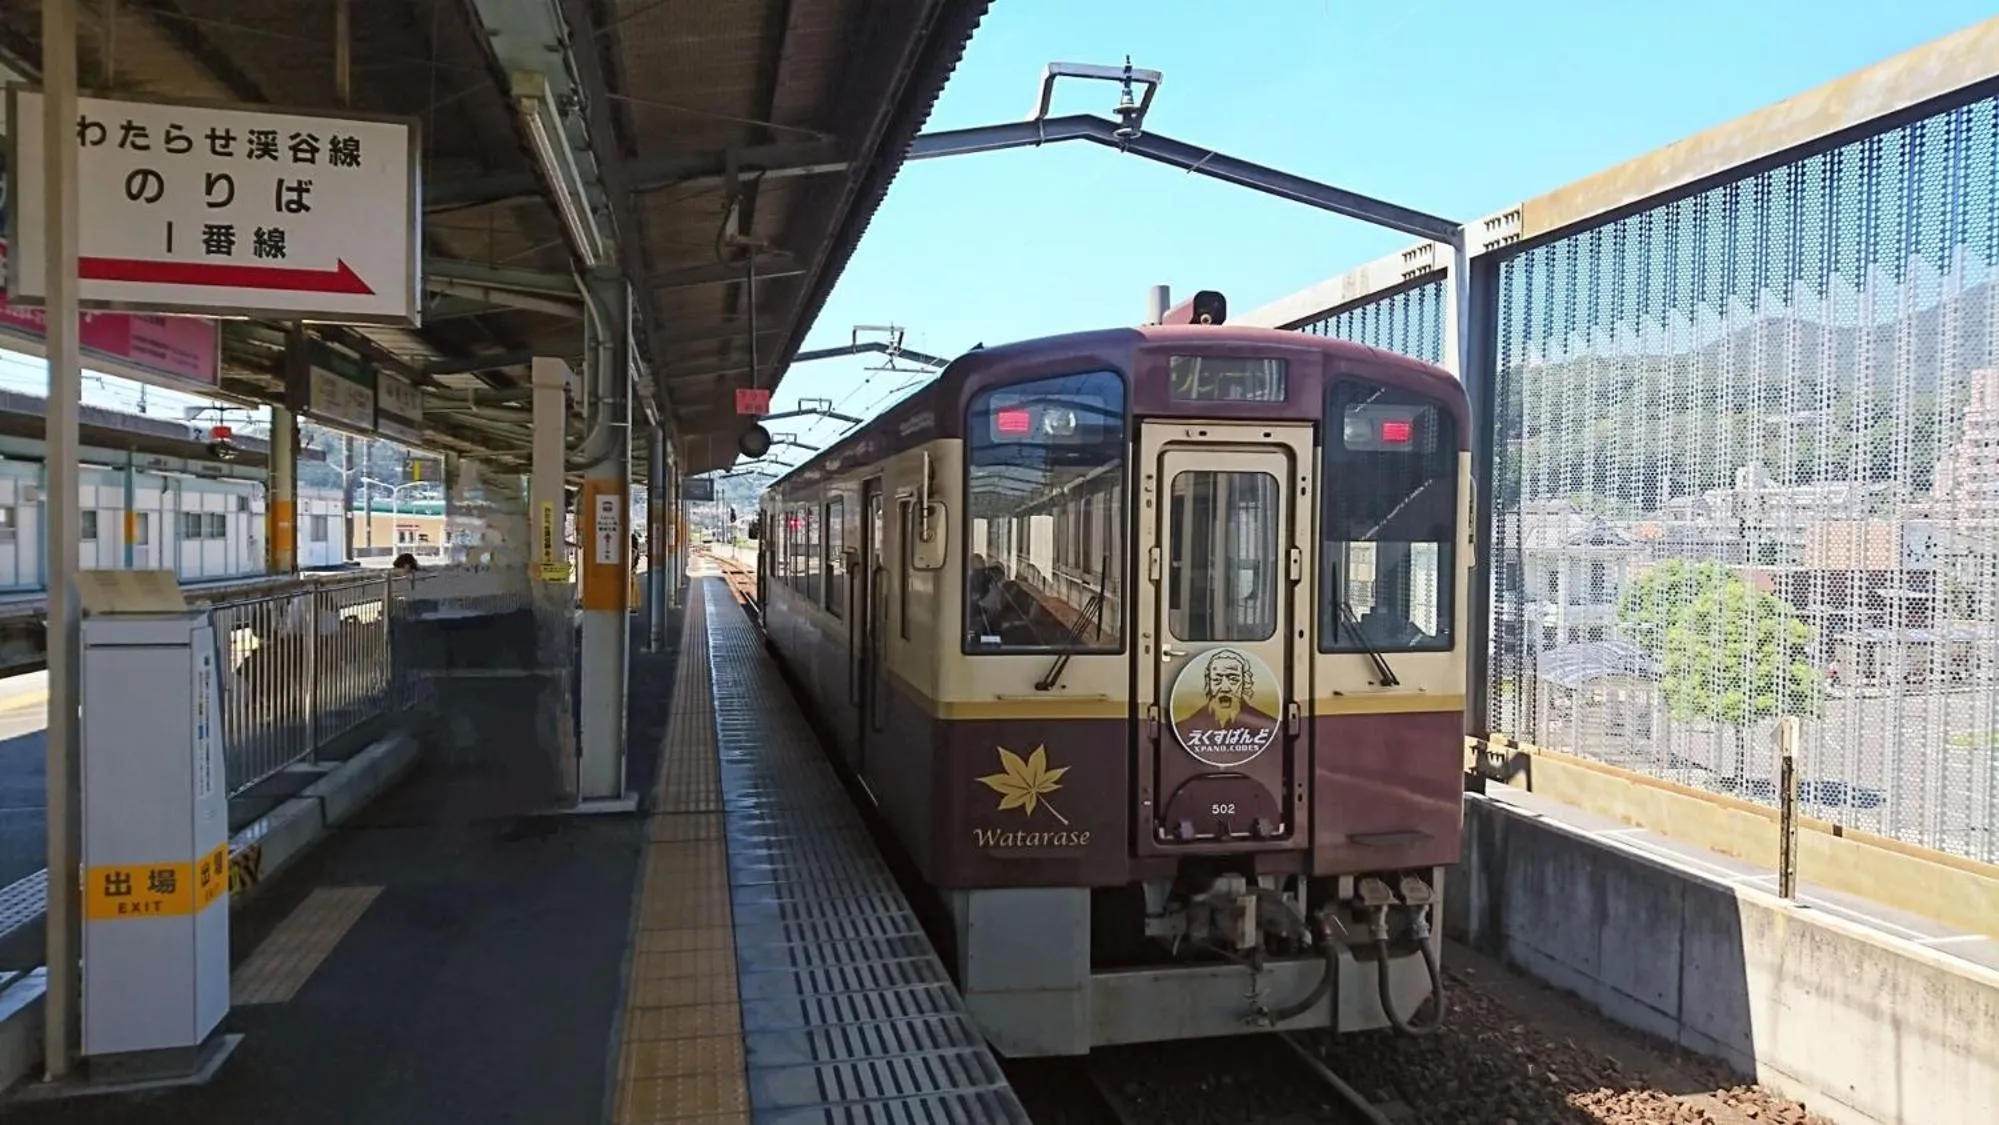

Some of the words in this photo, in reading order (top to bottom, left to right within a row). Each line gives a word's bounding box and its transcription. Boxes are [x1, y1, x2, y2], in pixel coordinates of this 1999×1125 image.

[77, 115, 361, 168] わたらせ渓谷線
[125, 167, 312, 214] のりば
[1211, 803, 1236, 814] 502
[973, 828, 1091, 847] Watarase
[104, 868, 177, 897] 出場
[118, 900, 163, 914] EXIT
